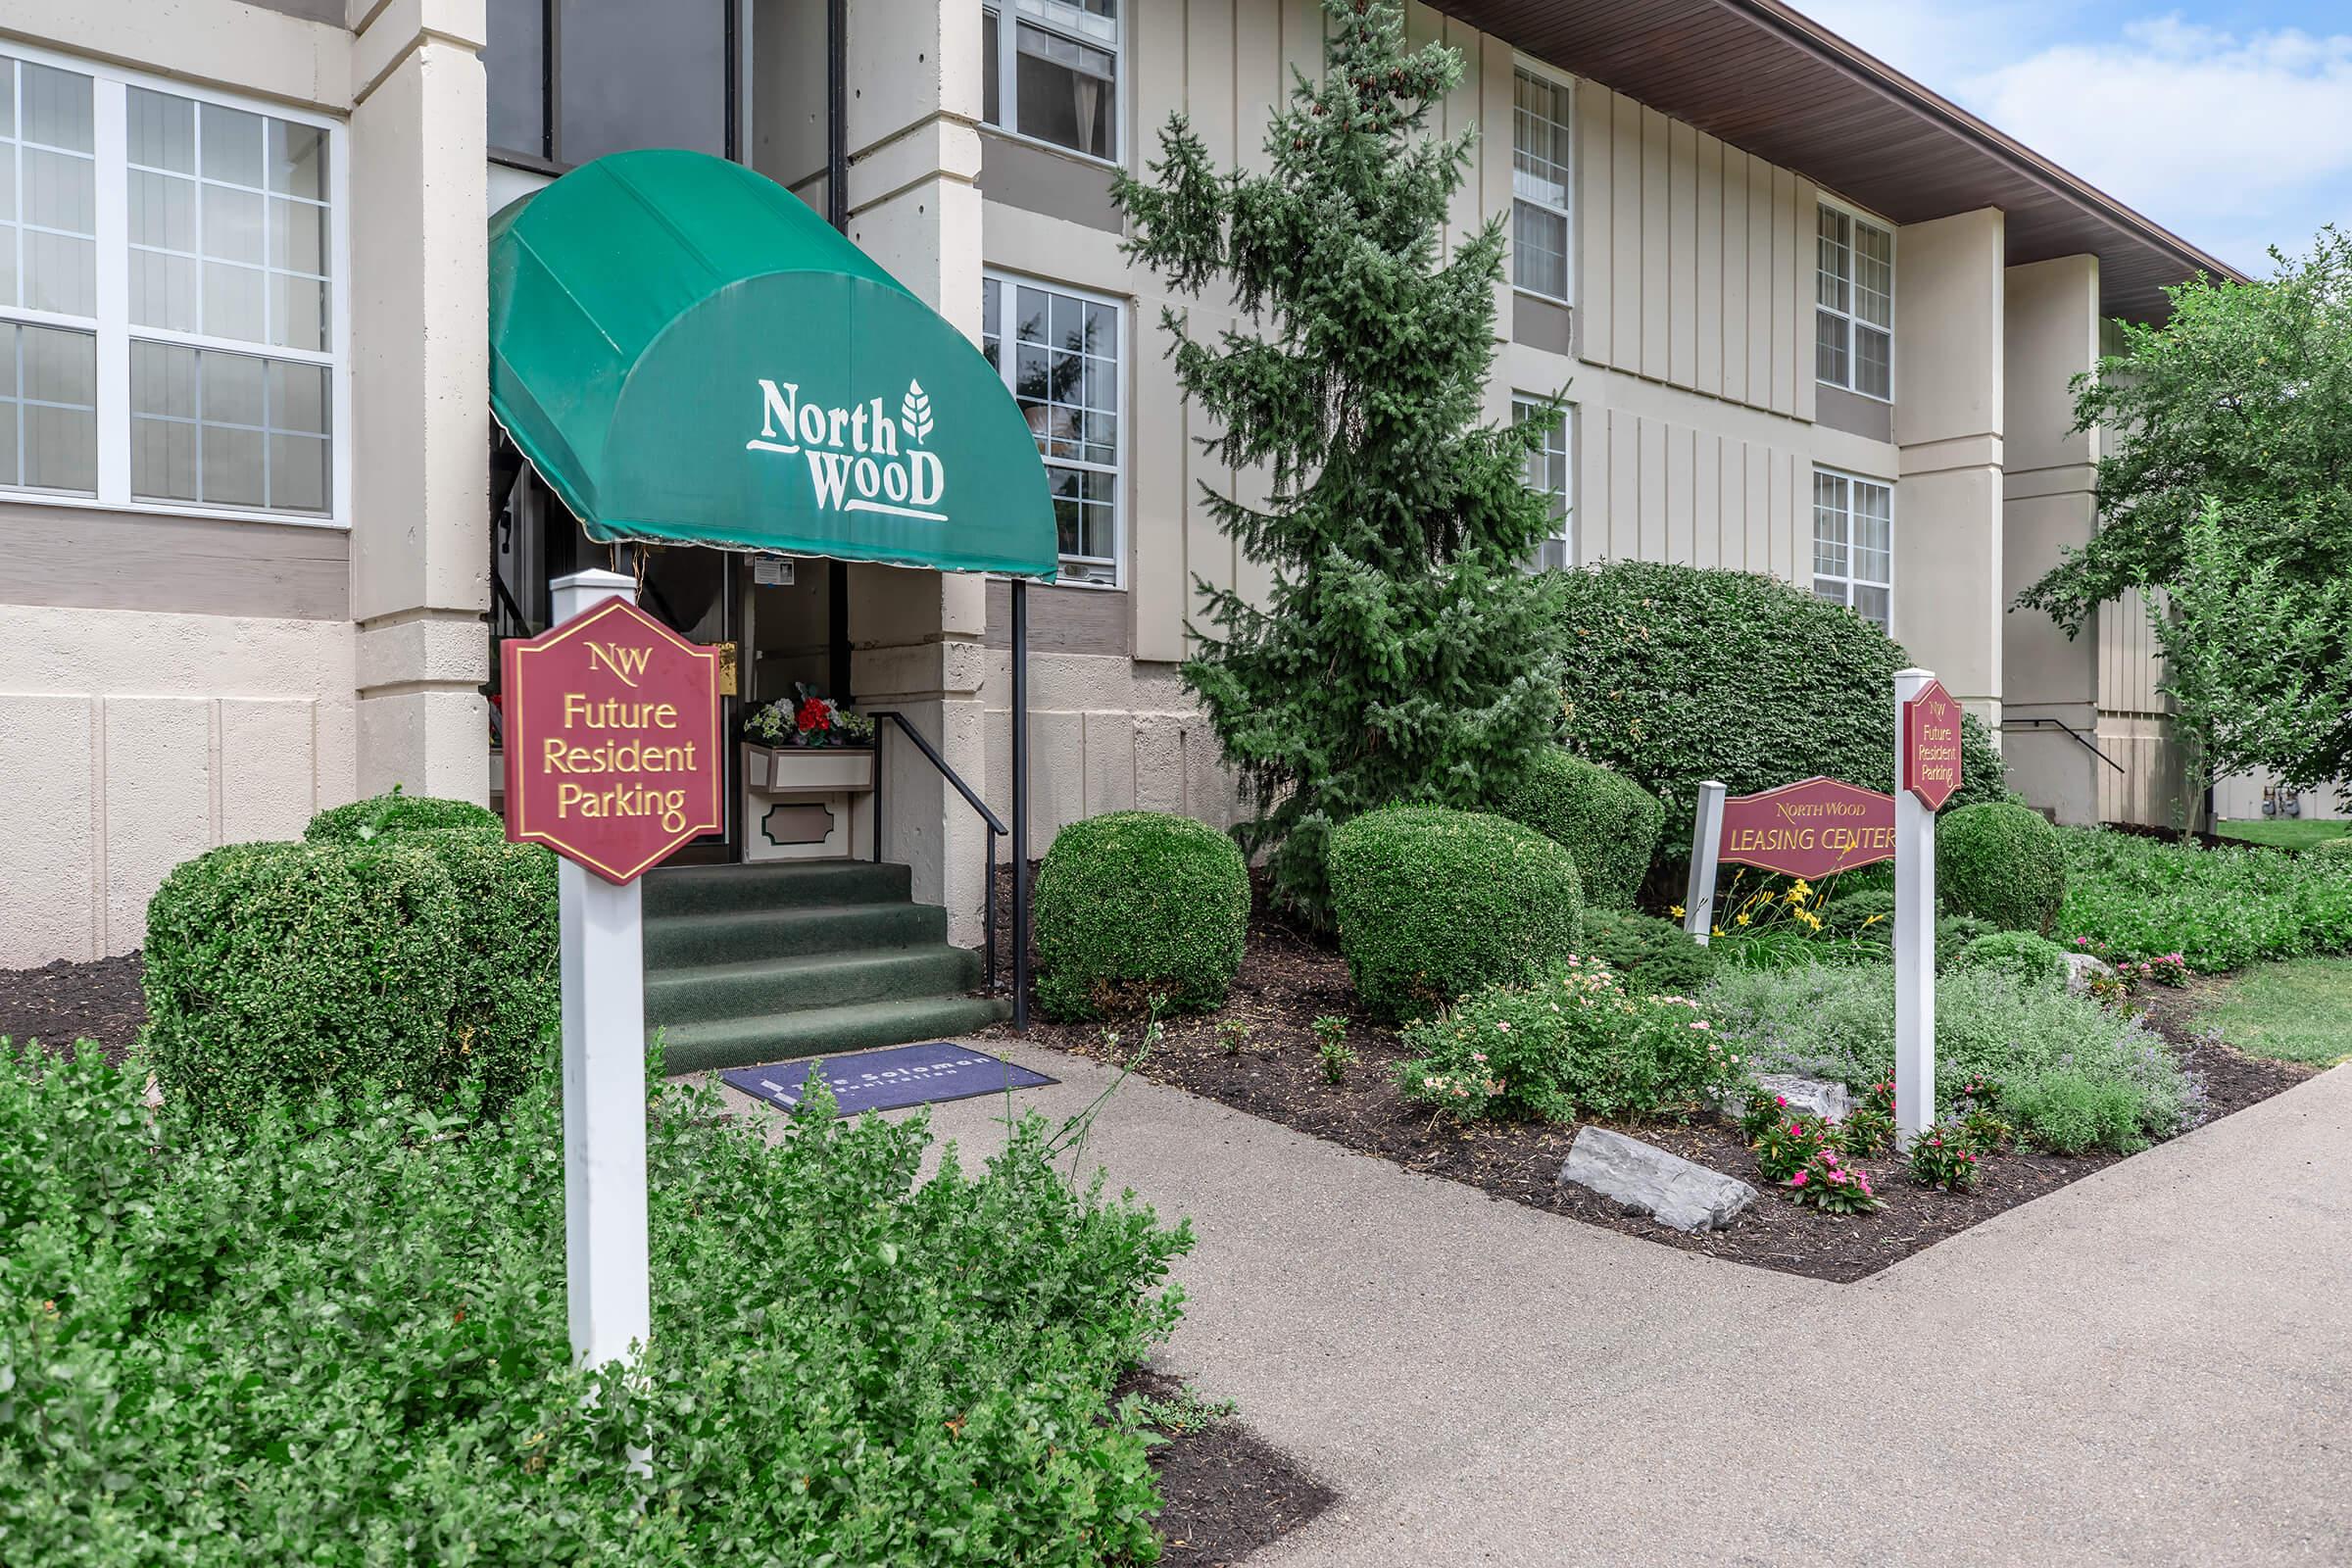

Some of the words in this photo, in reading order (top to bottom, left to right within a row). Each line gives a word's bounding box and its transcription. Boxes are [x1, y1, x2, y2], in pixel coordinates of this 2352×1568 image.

[759, 379, 899, 457] North
[584, 642, 653, 688] NW
[564, 693, 678, 729] Future
[1929, 701, 1945, 721] NW
[1924, 724, 1951, 741] Future
[543, 737, 697, 774] Resident
[1919, 745, 1956, 760] Resident
[1922, 764, 1953, 788] Parking
[558, 783, 686, 833] Parking
[1826, 802, 1866, 816] WOOD
[1731, 829, 1814, 852] LEASING
[861, 1057, 990, 1081] Solomon
